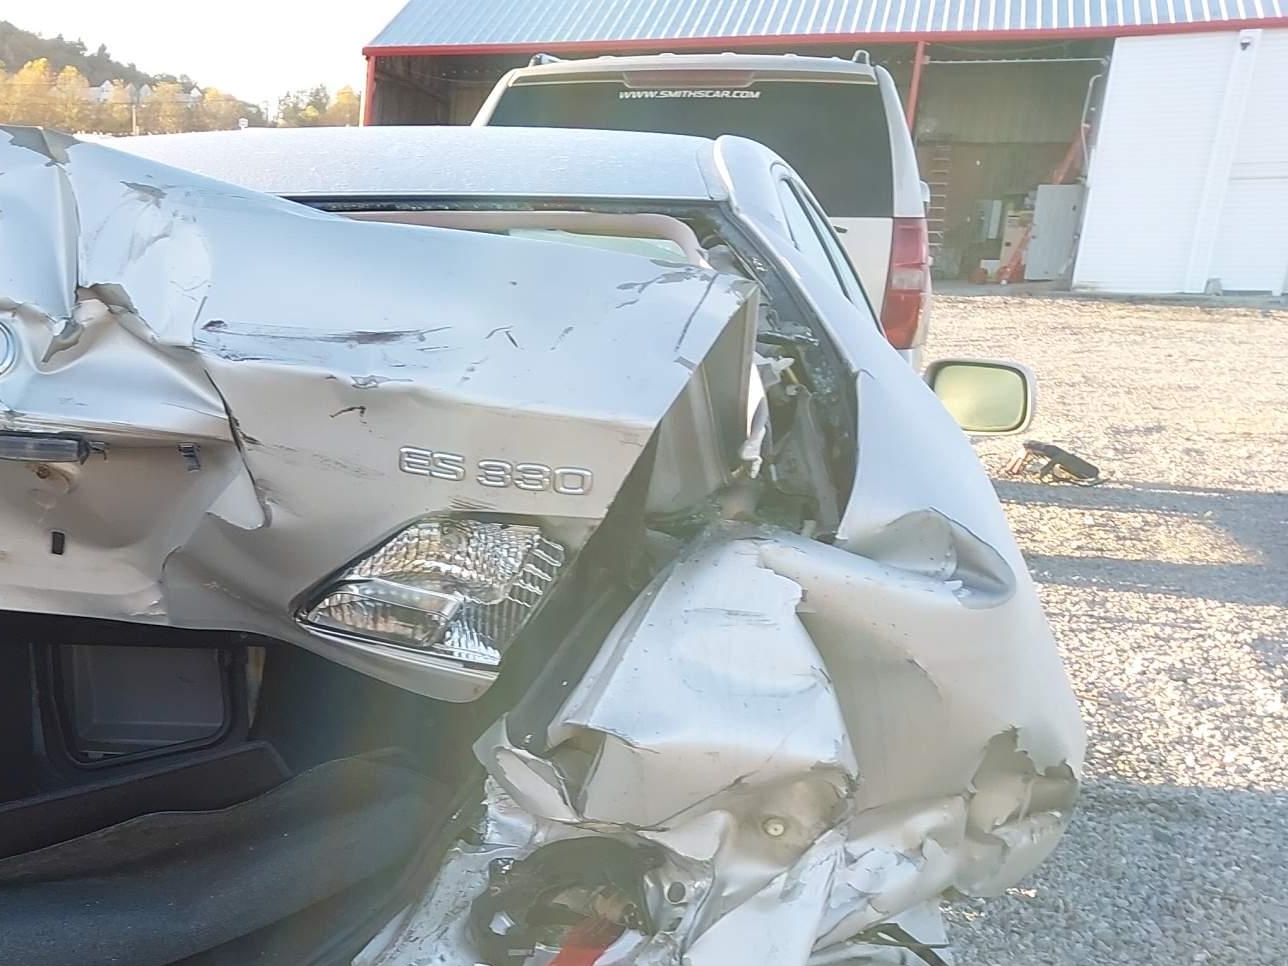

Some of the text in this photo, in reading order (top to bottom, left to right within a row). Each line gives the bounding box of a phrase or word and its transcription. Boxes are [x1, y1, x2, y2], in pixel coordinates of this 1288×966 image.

[618, 89, 761, 99] WWW.SMITHSCAR.COM
[399, 446, 593, 495] ES 330
